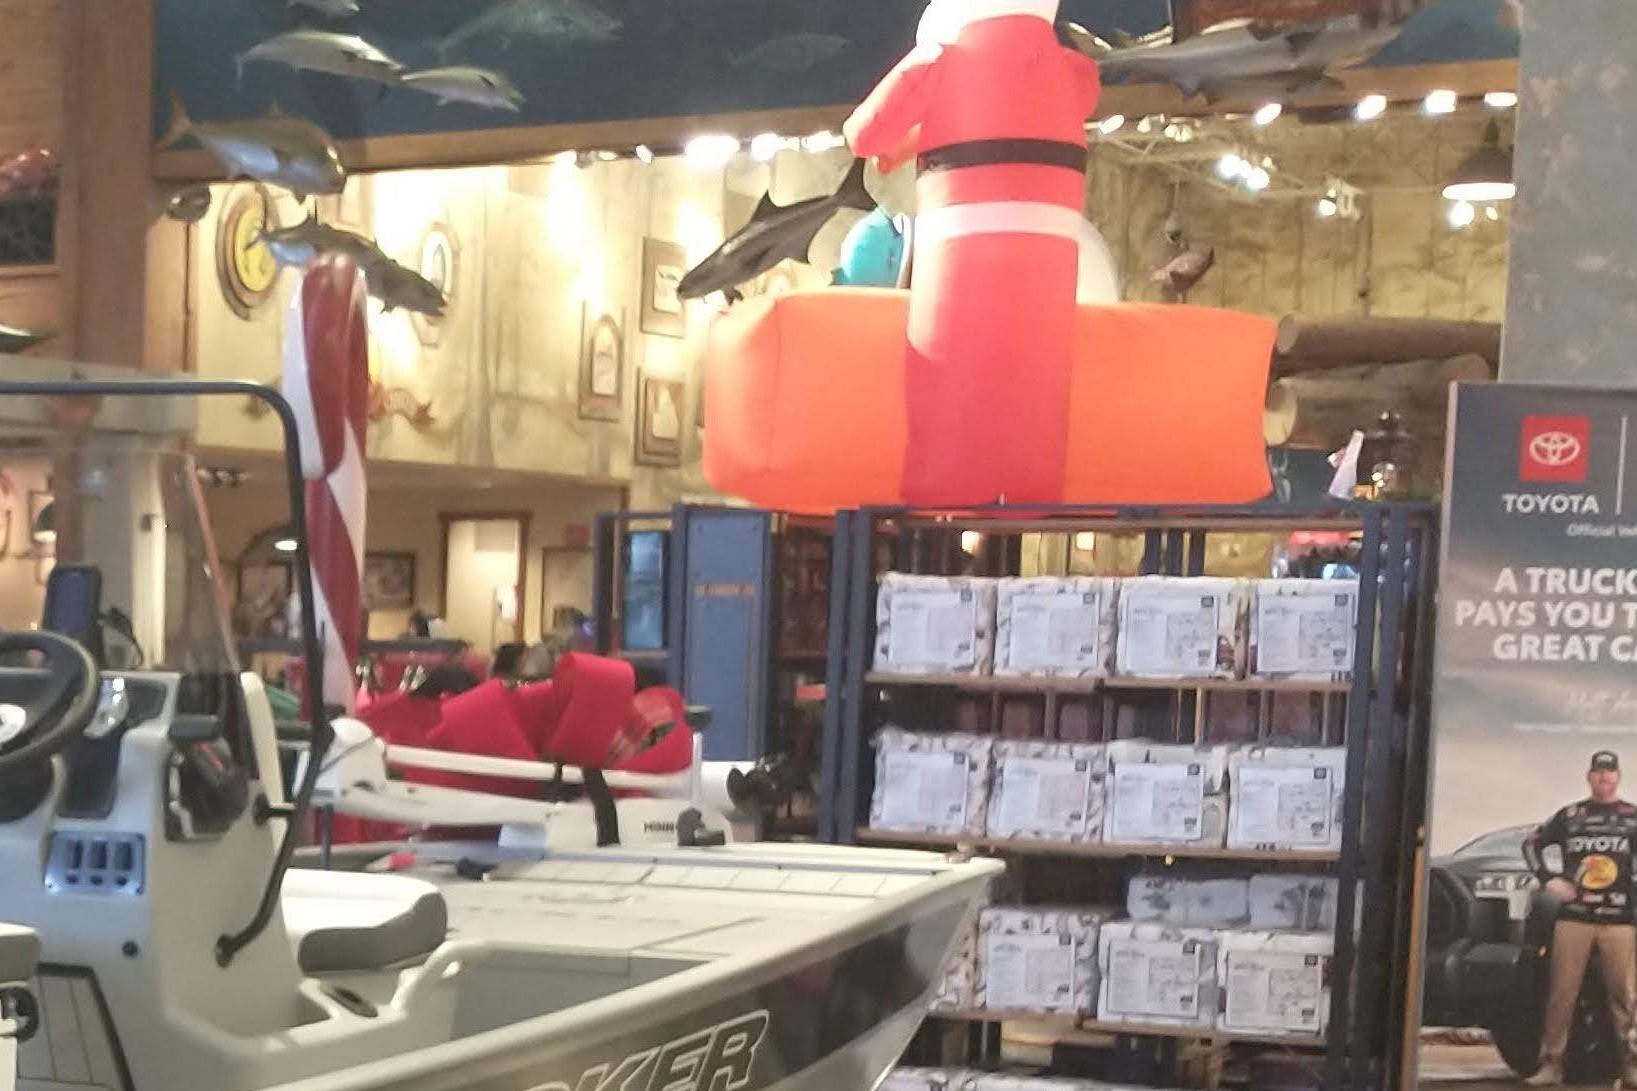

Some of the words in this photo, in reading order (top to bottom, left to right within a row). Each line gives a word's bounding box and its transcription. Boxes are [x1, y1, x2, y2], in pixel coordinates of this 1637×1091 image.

[1501, 493, 1601, 514] TOYOTA
[1494, 566, 1518, 594] A
[1525, 566, 1637, 595] TRUCK
[1455, 600, 1536, 627] PAYS
[1544, 601, 1615, 629] YOU
[1493, 633, 1606, 661] GREAT
